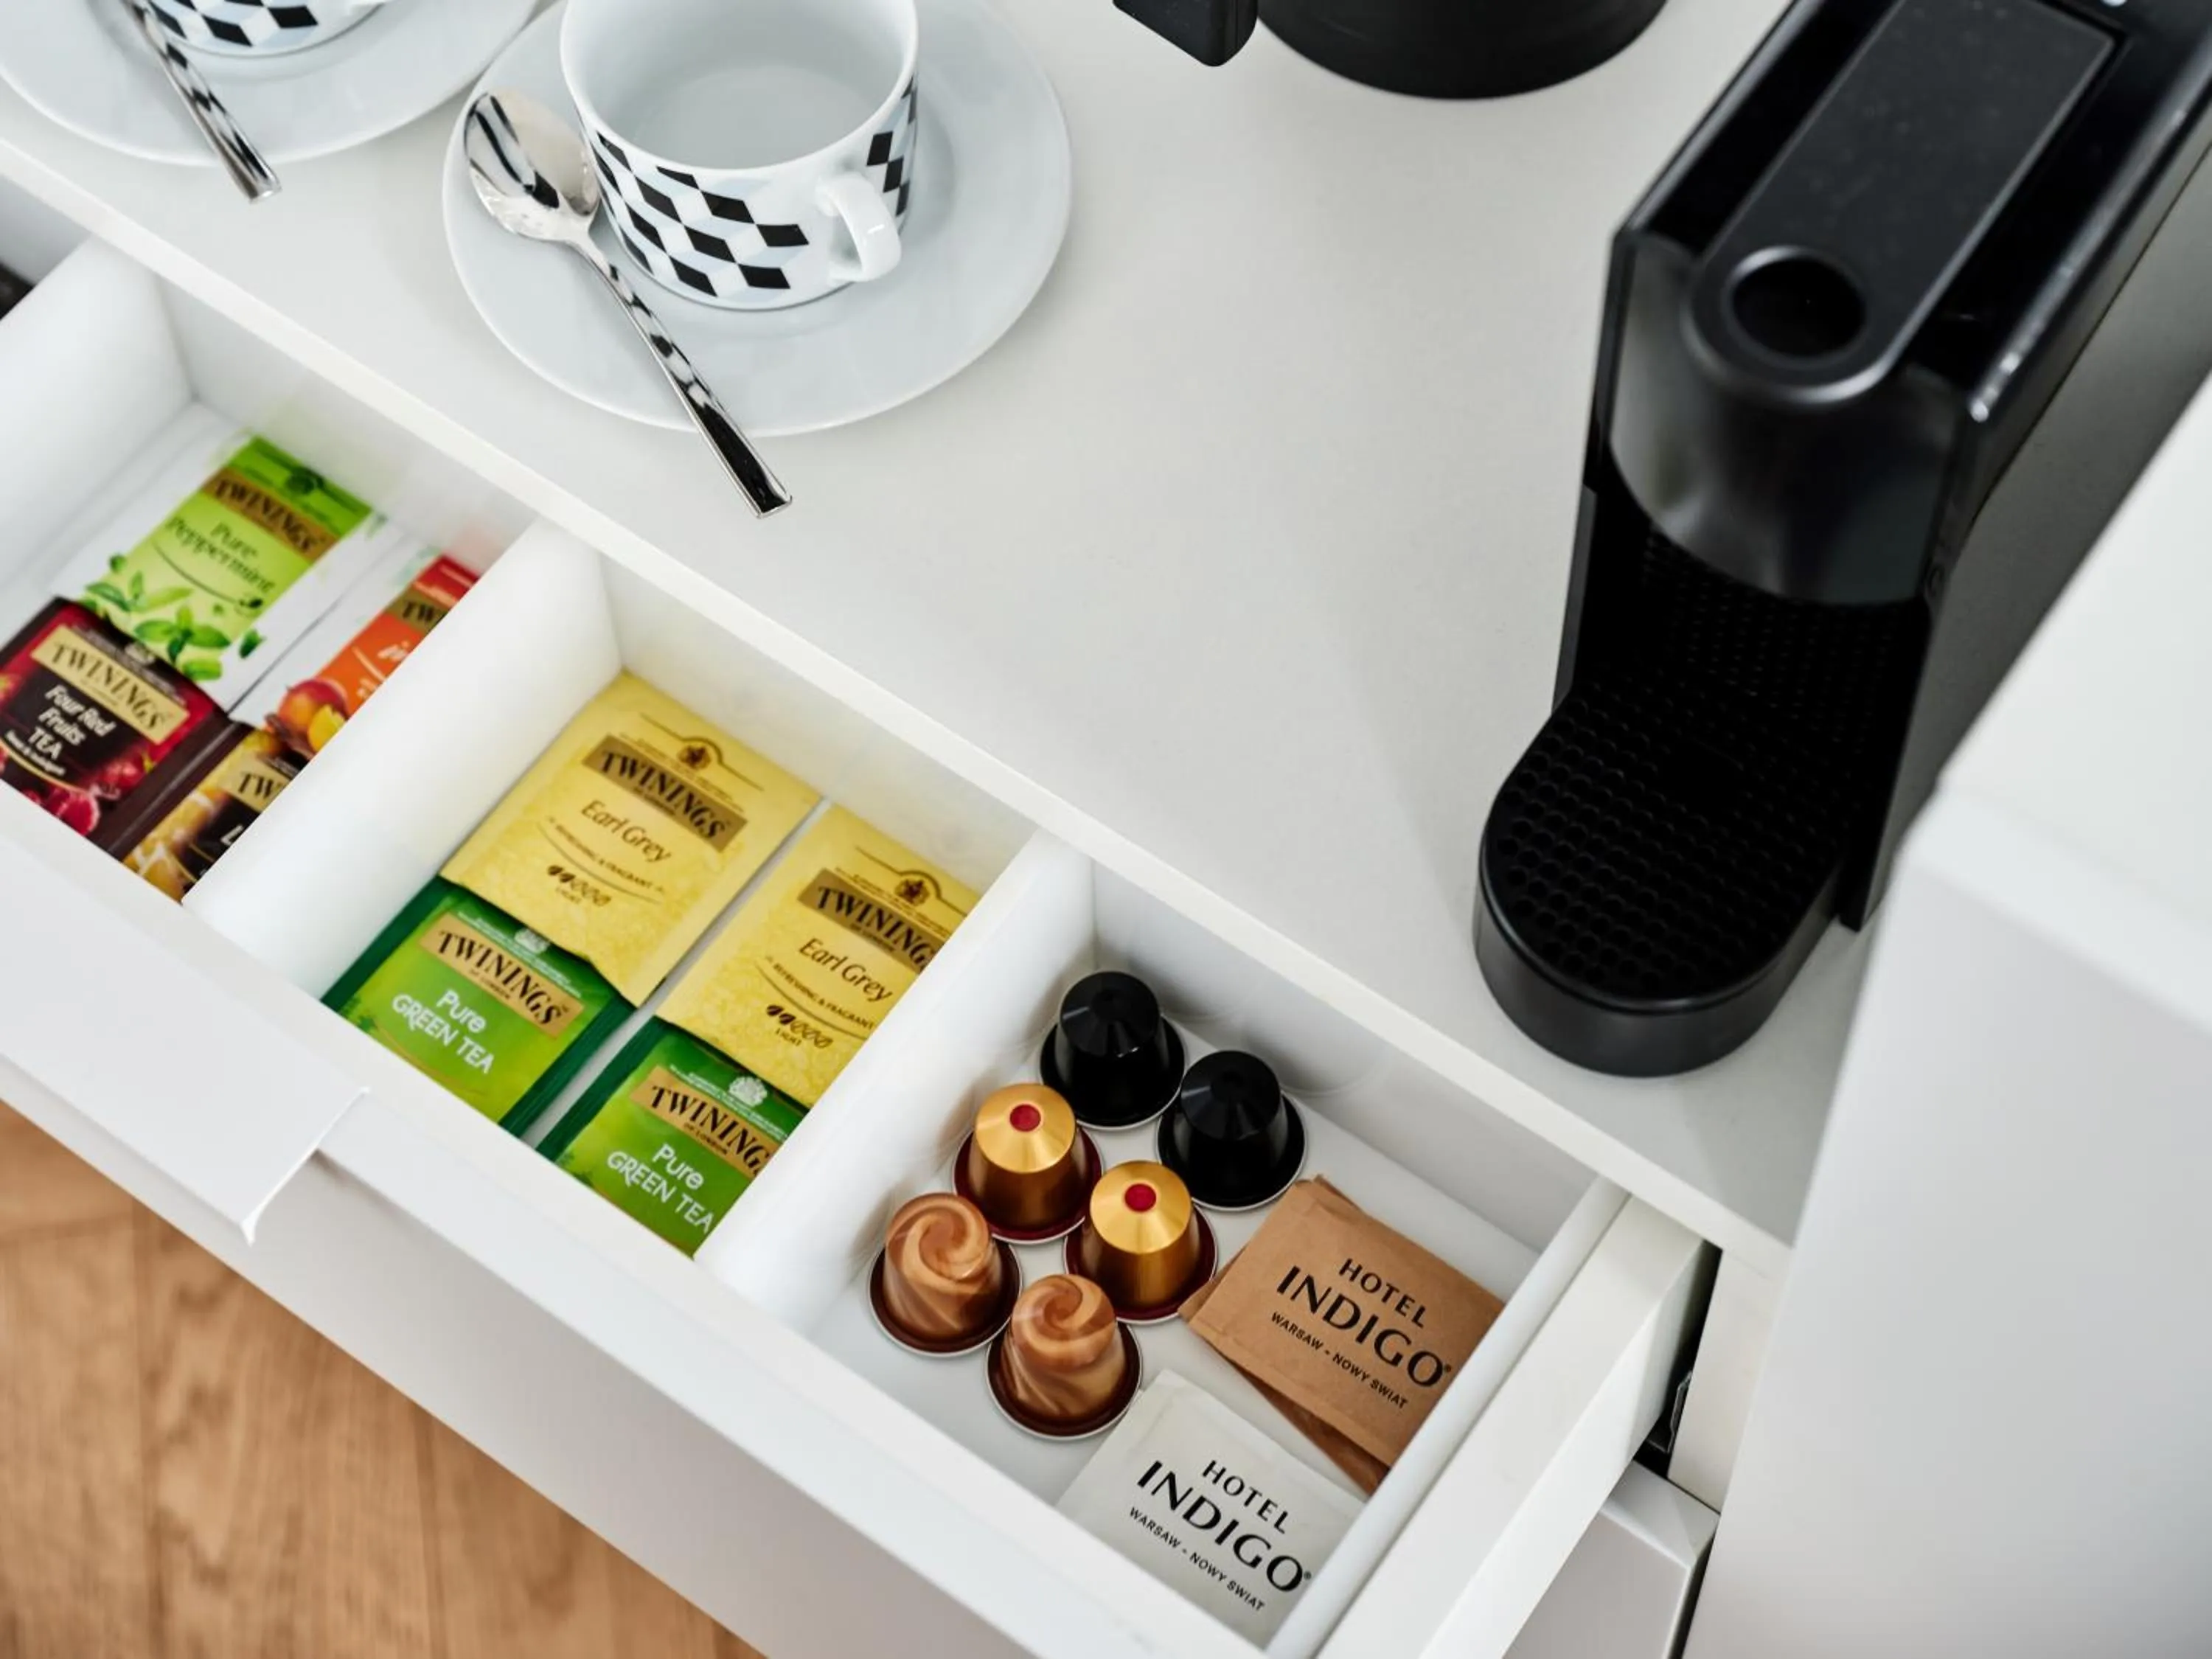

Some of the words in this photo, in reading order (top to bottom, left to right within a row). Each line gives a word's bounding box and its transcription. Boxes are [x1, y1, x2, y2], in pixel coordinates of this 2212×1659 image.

[215, 479, 317, 552] TWININGS
[54, 641, 163, 729] TWININGS
[28, 726, 62, 760] TEA
[582, 799, 630, 833] Earl
[622, 826, 672, 863] Grey
[602, 751, 726, 839] TWININGS
[818, 886, 936, 972] TWINING
[439, 931, 562, 1025] TWININGS
[799, 938, 849, 972] Earl
[842, 964, 893, 1002] Grey
[392, 994, 459, 1047] GREEN
[456, 1036, 495, 1074] TEA
[437, 989, 487, 1033] Pure
[651, 1085, 771, 1176] TWINING
[653, 1143, 704, 1190] Pure
[607, 1151, 677, 1203] GREEN
[675, 1193, 714, 1234] TEA
[1338, 1258, 1427, 1329] HOTEL
[1271, 1312, 1324, 1351] WARSAW
[1332, 1352, 1371, 1382] NOWY
[1370, 1378, 1409, 1409] SWIAT
[1202, 1460, 1289, 1534] HOTEL
[1130, 1507, 1181, 1548] WARSAW
[1190, 1552, 1228, 1582] NOWY
[1227, 1580, 1265, 1611] SWIAT
